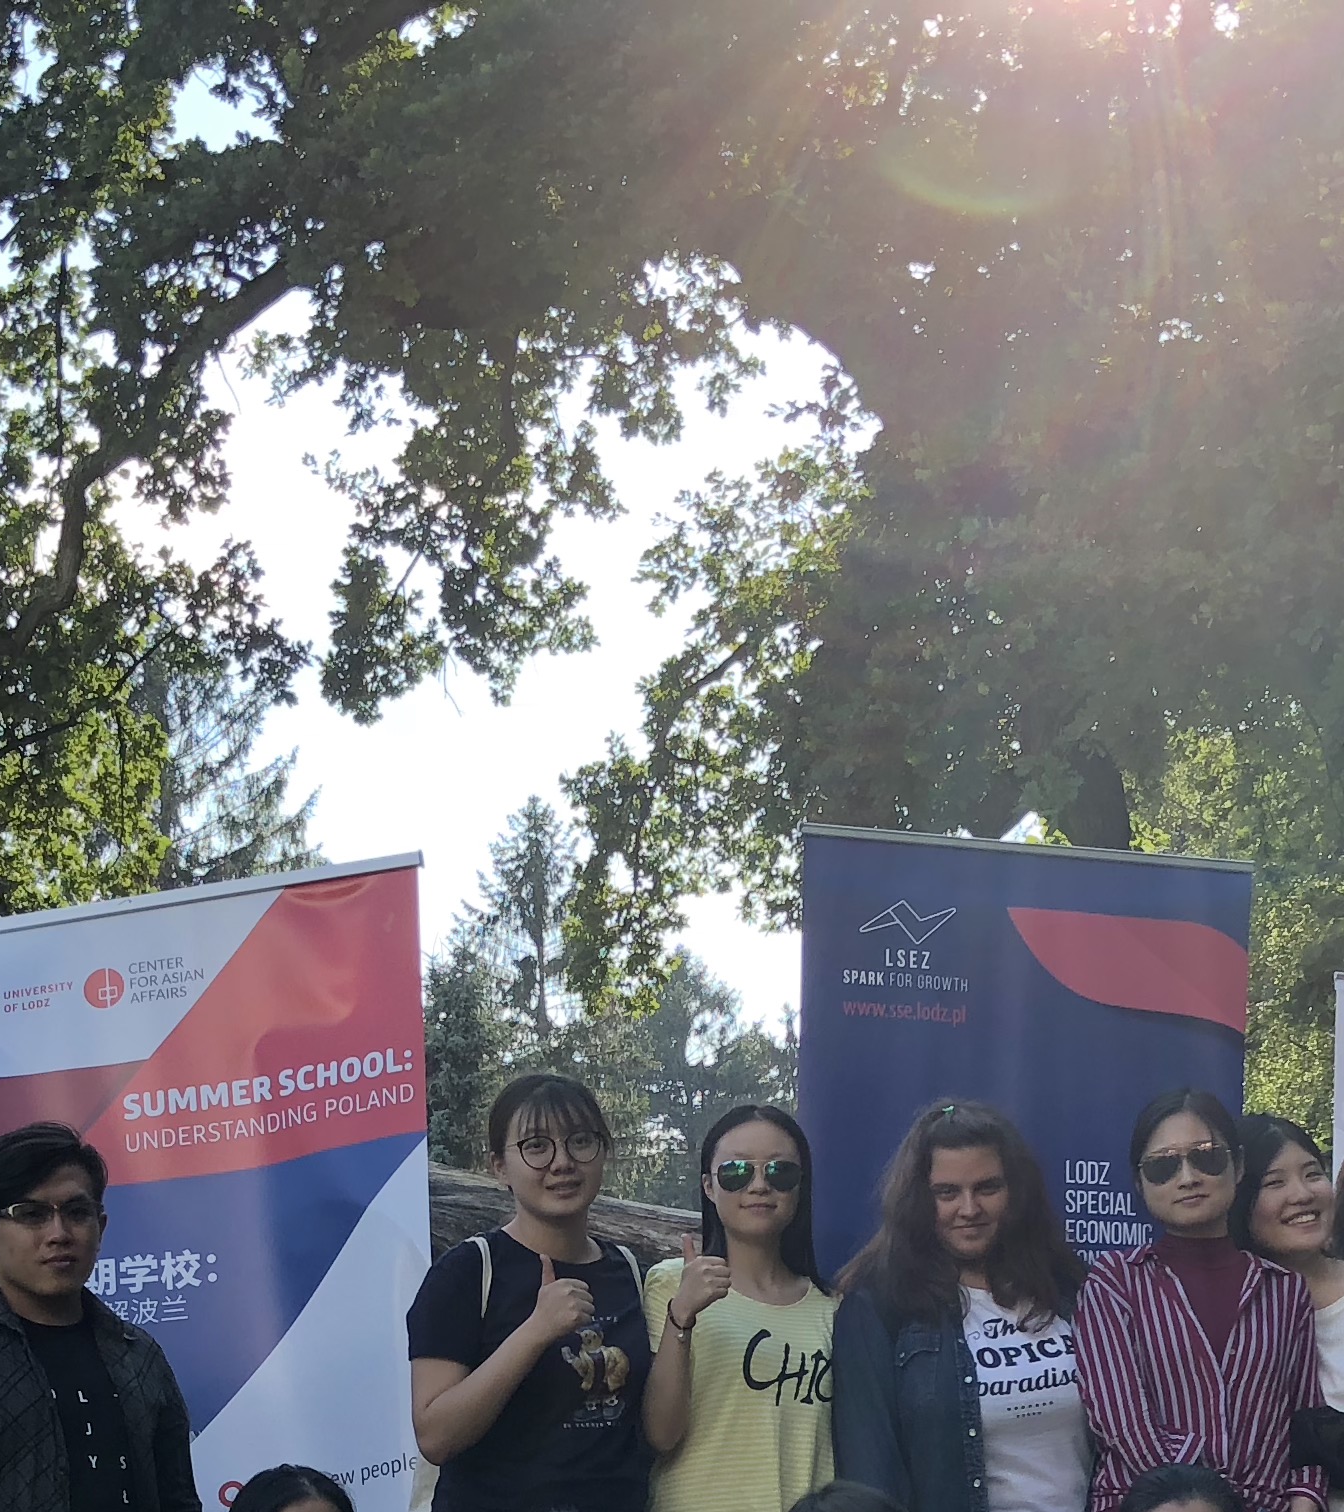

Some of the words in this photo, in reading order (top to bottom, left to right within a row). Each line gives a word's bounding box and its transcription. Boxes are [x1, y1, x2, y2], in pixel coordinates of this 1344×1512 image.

[128, 956, 184, 975] CENTER
[885, 948, 930, 969] LSEZ
[3, 981, 74, 1000] UNIVERSITY
[129, 974, 158, 990] FOR
[161, 968, 205, 986] ASIAN
[843, 969, 884, 986] SPARK
[889, 972, 912, 988] FOR
[917, 974, 968, 992] GROWTH
[3, 1003, 19, 1014] OF
[22, 998, 51, 1012] LODZ
[130, 986, 188, 1005] AFFAIRS
[843, 1000, 966, 1027] www.sse.lodz.pl
[123, 1075, 273, 1121] SUMMER
[278, 1047, 413, 1097] SCHOOL:
[125, 1102, 317, 1153] UNDERSTANDING
[325, 1083, 414, 1119] POLAND
[1065, 1159, 1110, 1185] LODZ
[1065, 1189, 1137, 1216] SPECIAL
[1065, 1219, 1153, 1246] ECONOMIC
